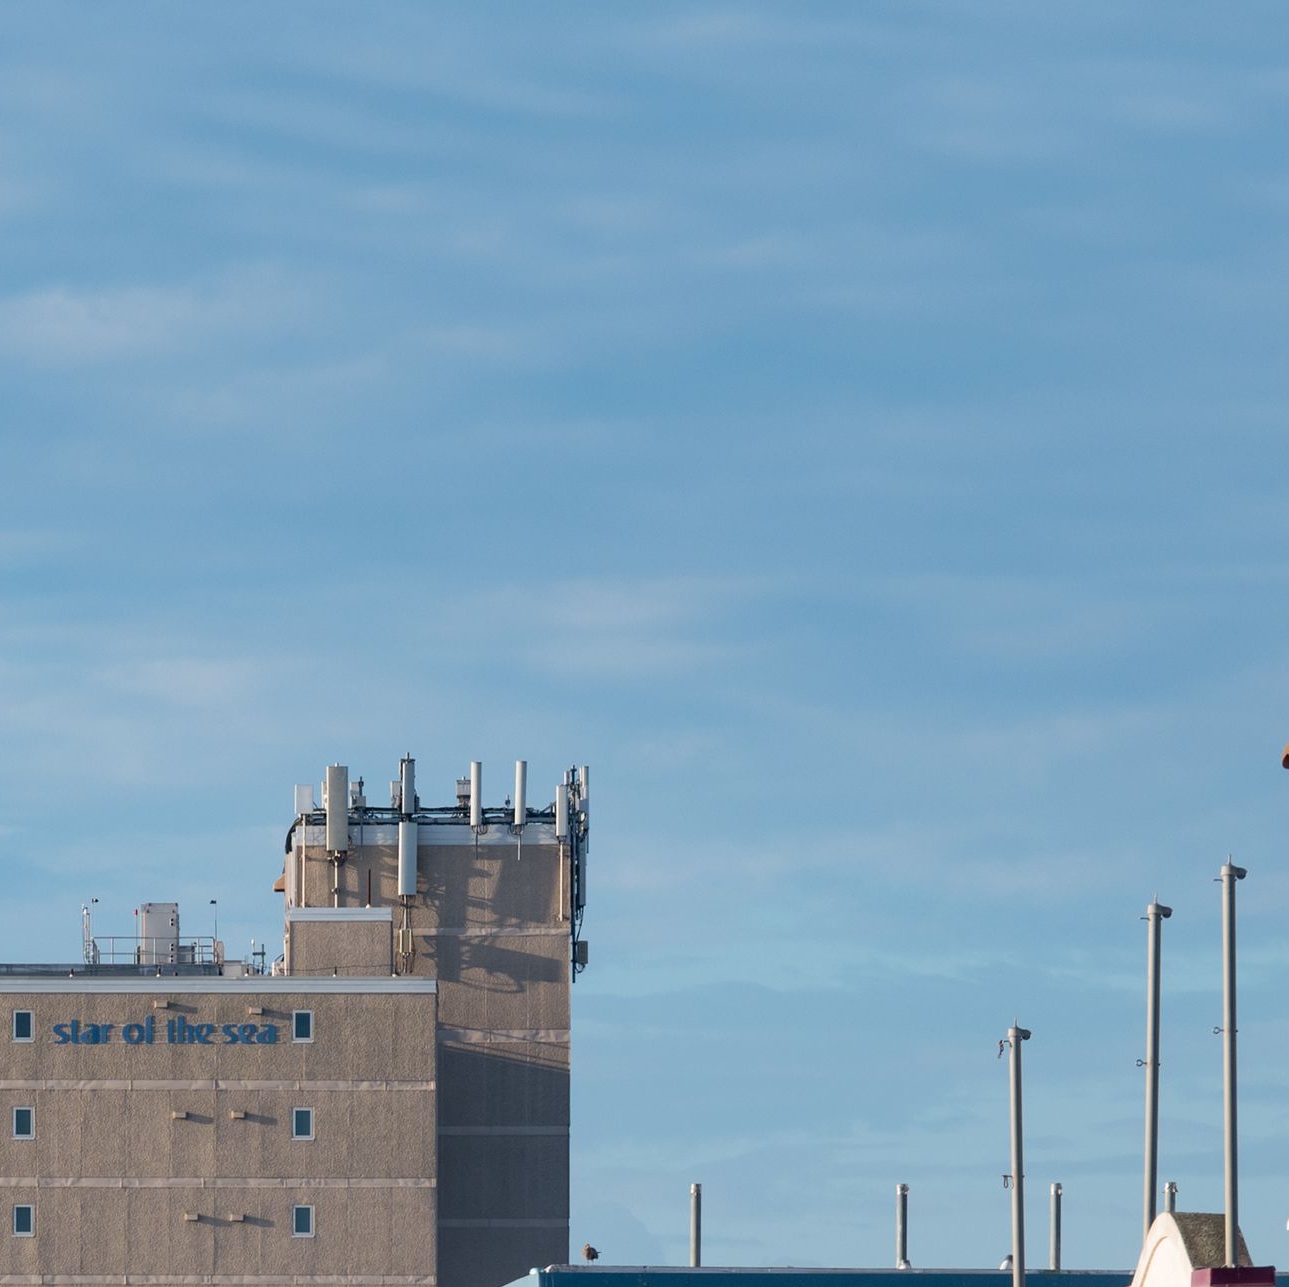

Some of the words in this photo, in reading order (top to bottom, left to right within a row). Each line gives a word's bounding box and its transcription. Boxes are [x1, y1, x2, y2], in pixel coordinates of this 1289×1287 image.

[53, 1019, 114, 1044] star
[121, 1015, 156, 1044] of
[166, 1015, 214, 1044] the
[222, 1023, 279, 1044] sea
